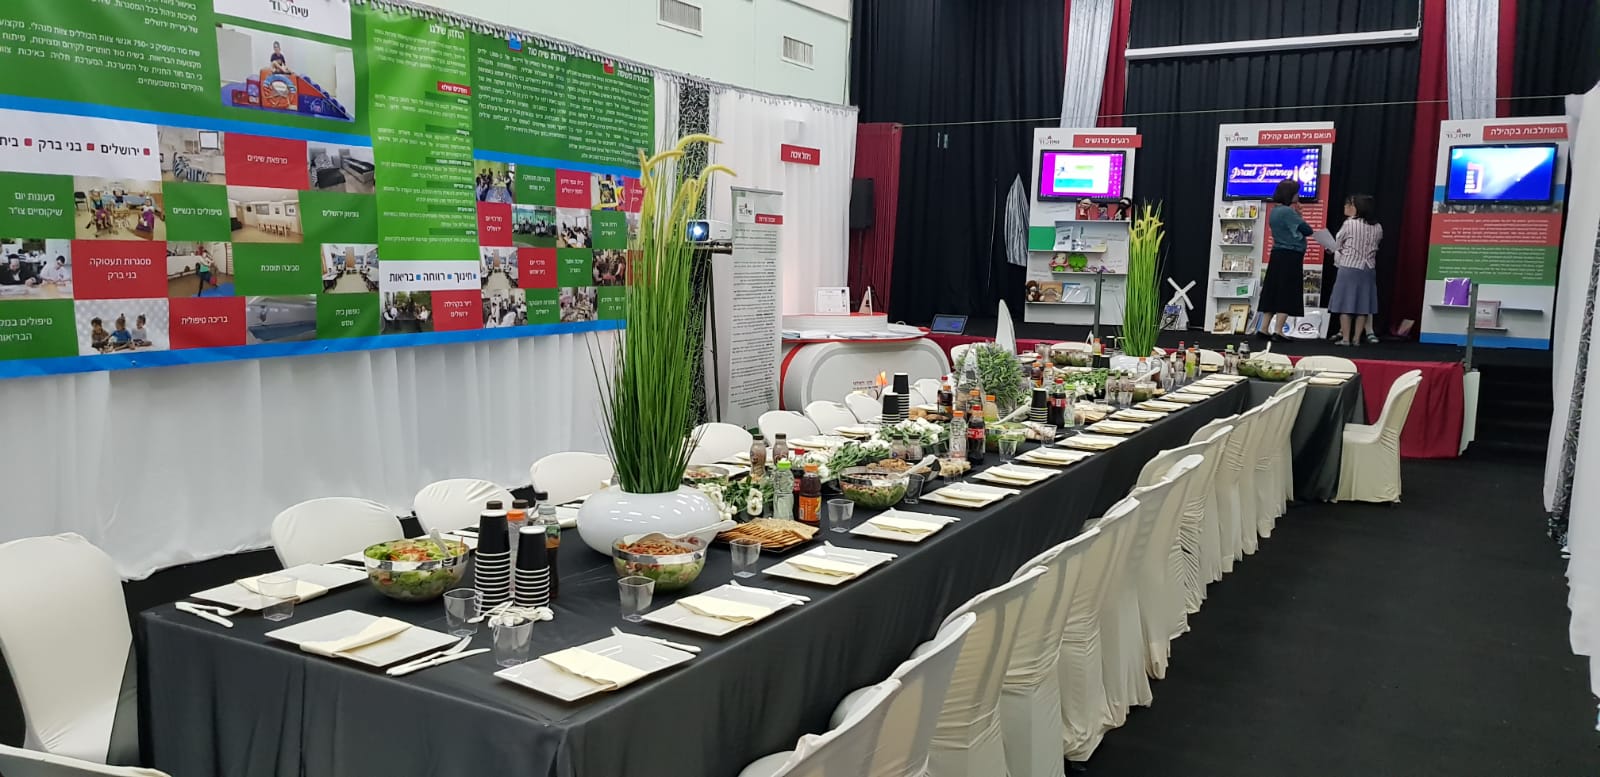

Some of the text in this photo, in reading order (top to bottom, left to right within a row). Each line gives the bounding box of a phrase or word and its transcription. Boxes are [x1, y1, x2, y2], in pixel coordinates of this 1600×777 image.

[1261, 132, 1282, 141] קהילה
[1490, 126, 1564, 136] השתלבות בקהילה
[38, 140, 62, 152] ברק
[66, 142, 82, 152] בני
[100, 143, 140, 156] ירושלים
[1230, 166, 1294, 181] Israel Journey
[108, 271, 124, 280] ברק
[390, 272, 472, 284] חינוך רווחה בריאות
